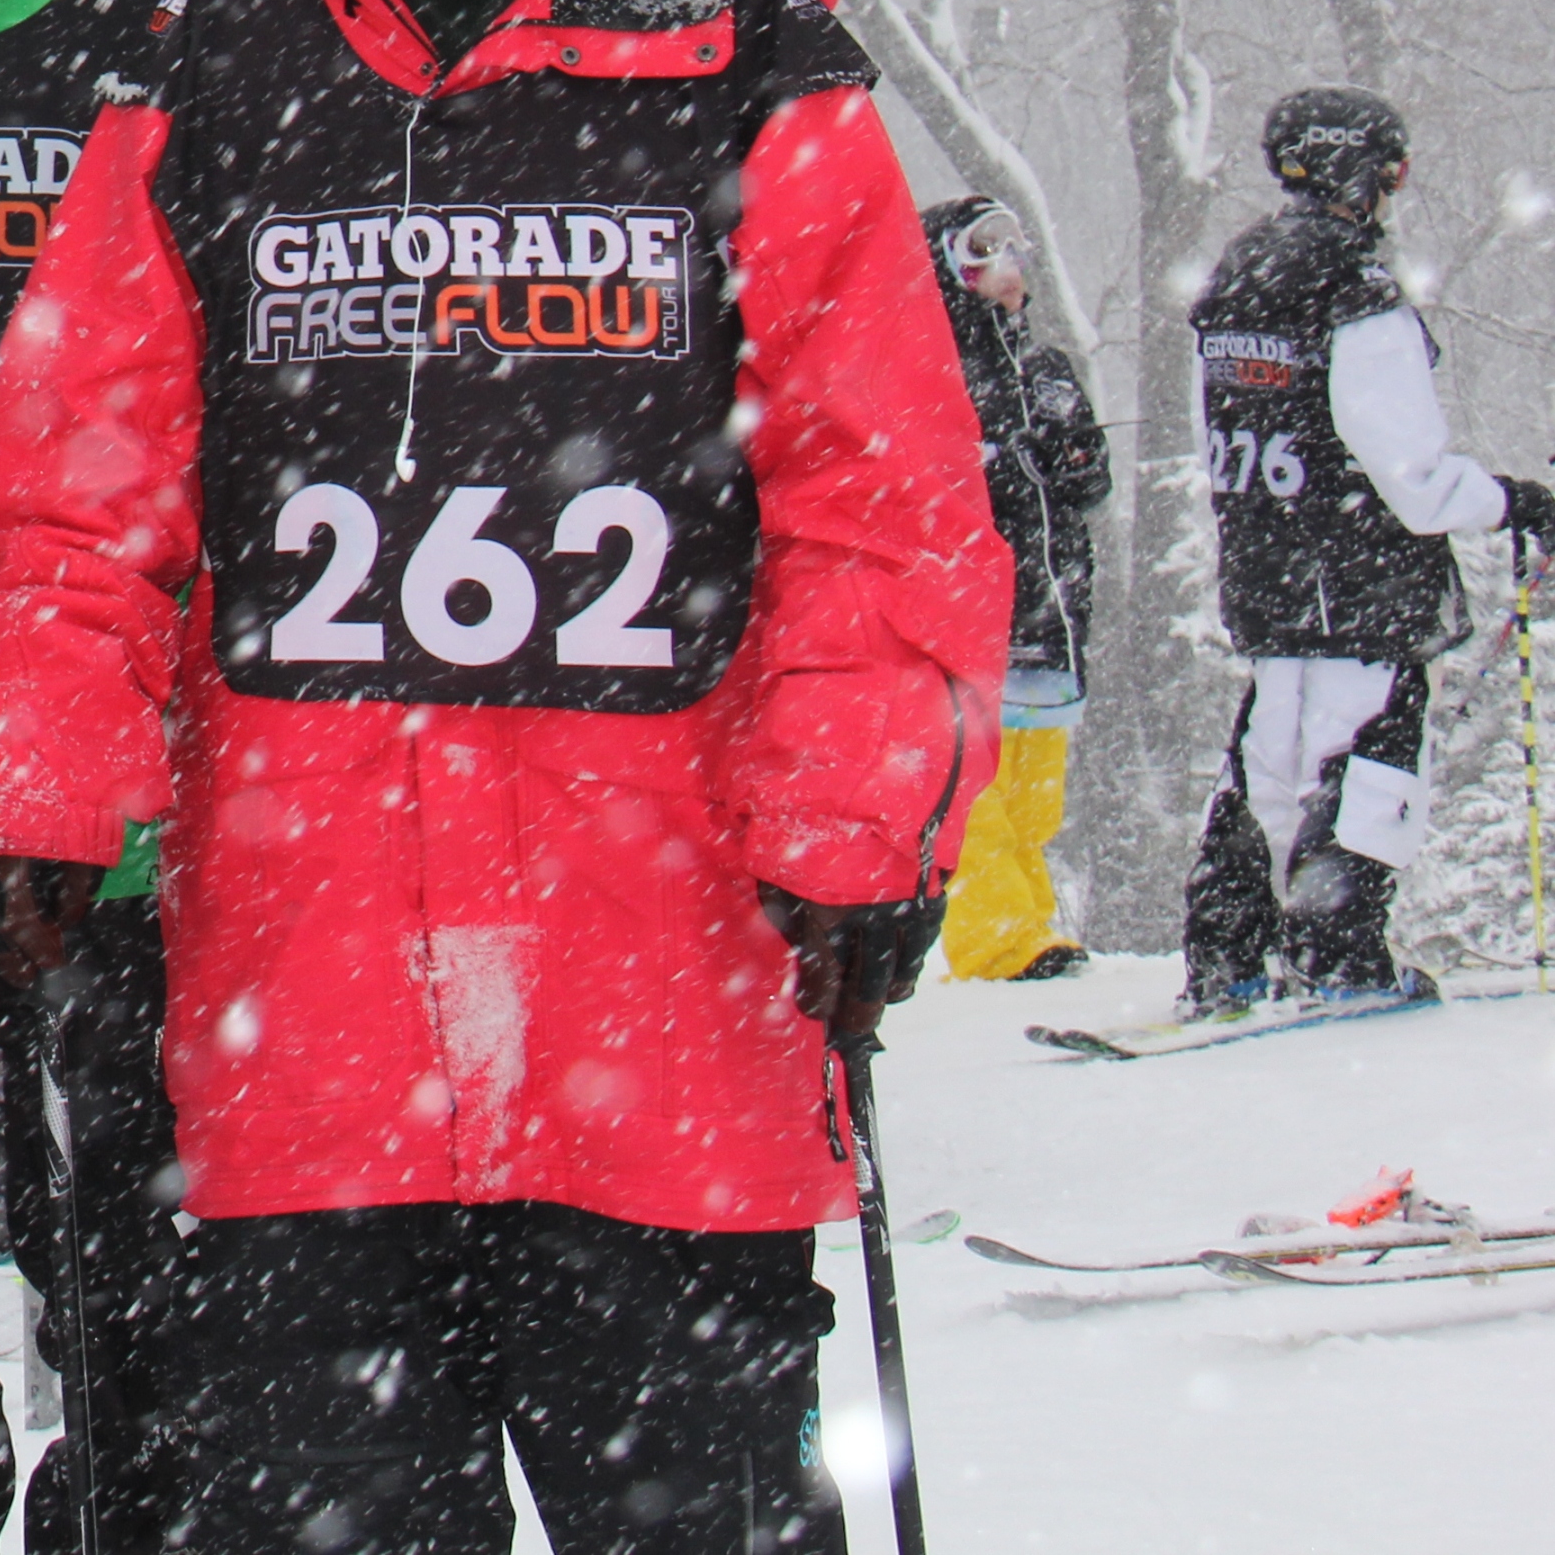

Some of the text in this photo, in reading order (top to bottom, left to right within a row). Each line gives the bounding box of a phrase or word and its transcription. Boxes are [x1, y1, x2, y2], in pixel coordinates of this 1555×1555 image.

[255, 214, 678, 287] GATORADE
[256, 283, 660, 352] FREE FLOW
[662, 286, 677, 348] TOUR
[1209, 429, 1306, 497] 276
[270, 482, 675, 668] 262
